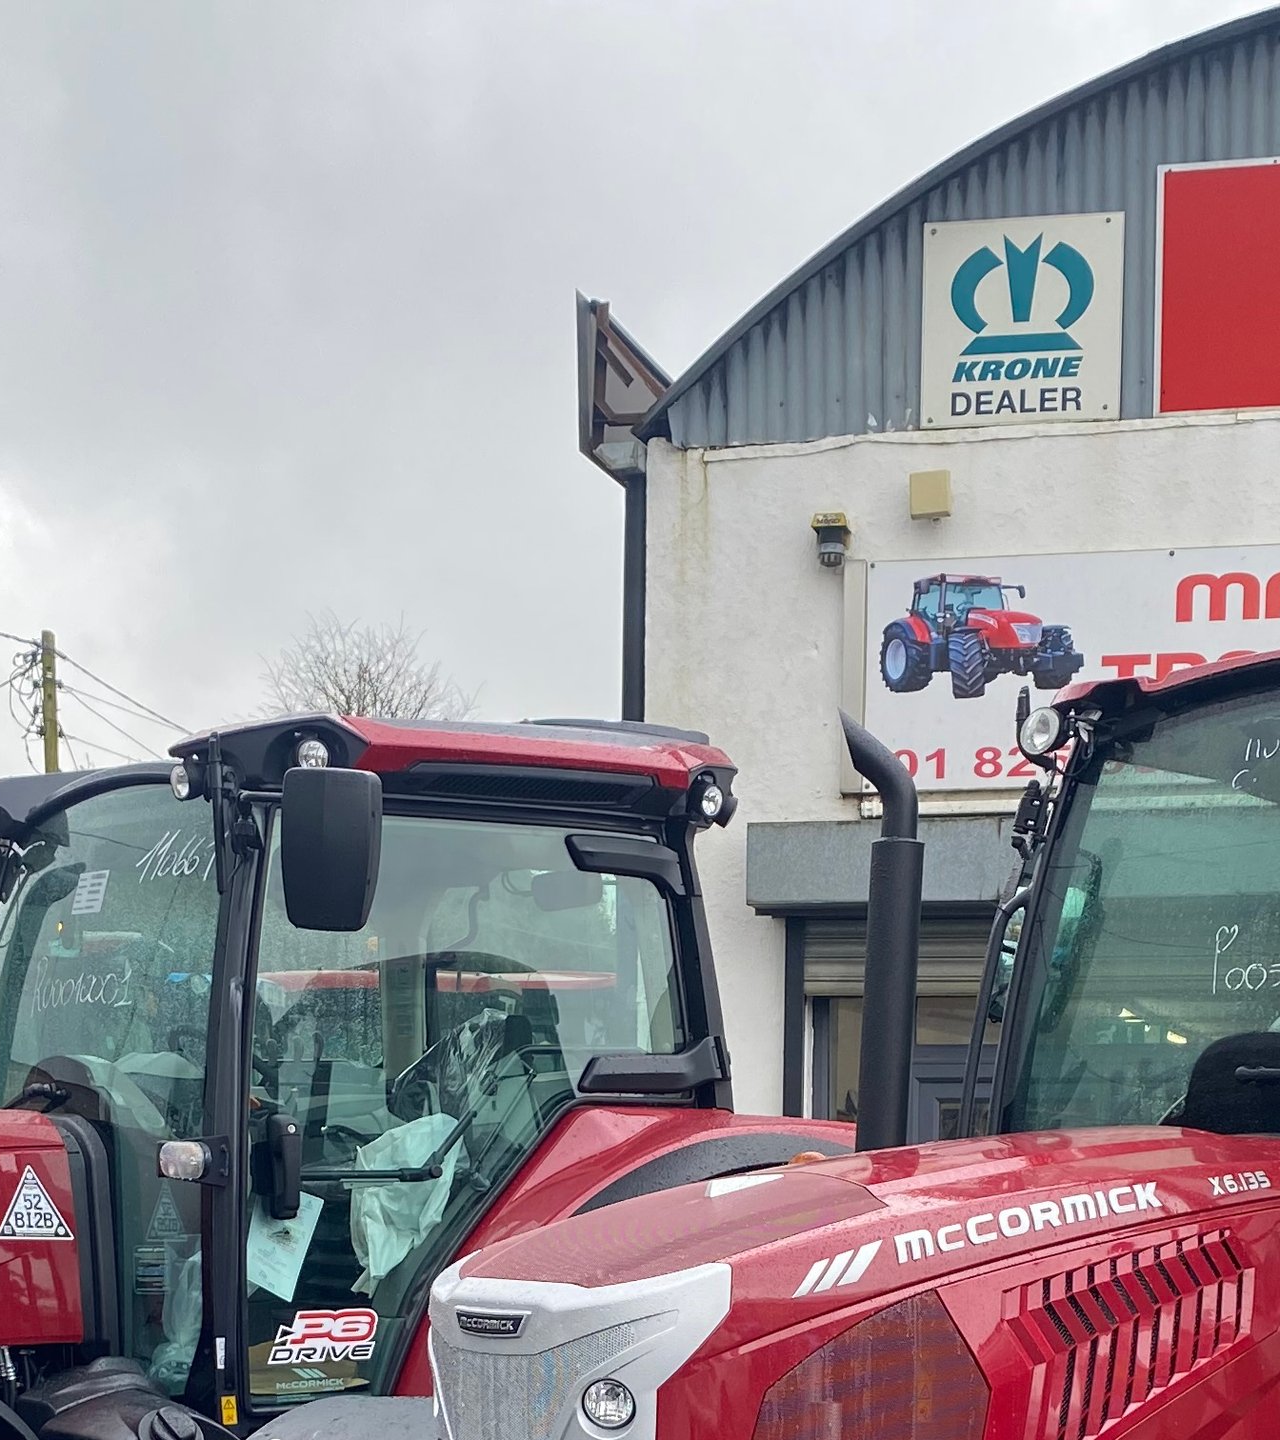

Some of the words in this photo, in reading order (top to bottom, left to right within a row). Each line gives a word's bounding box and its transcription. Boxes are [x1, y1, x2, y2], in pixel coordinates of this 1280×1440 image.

[952, 355, 1083, 382] KRONE
[950, 386, 1082, 416] DEALER
[291, 1311, 375, 1345] P6
[271, 1344, 373, 1362] DRIVE
